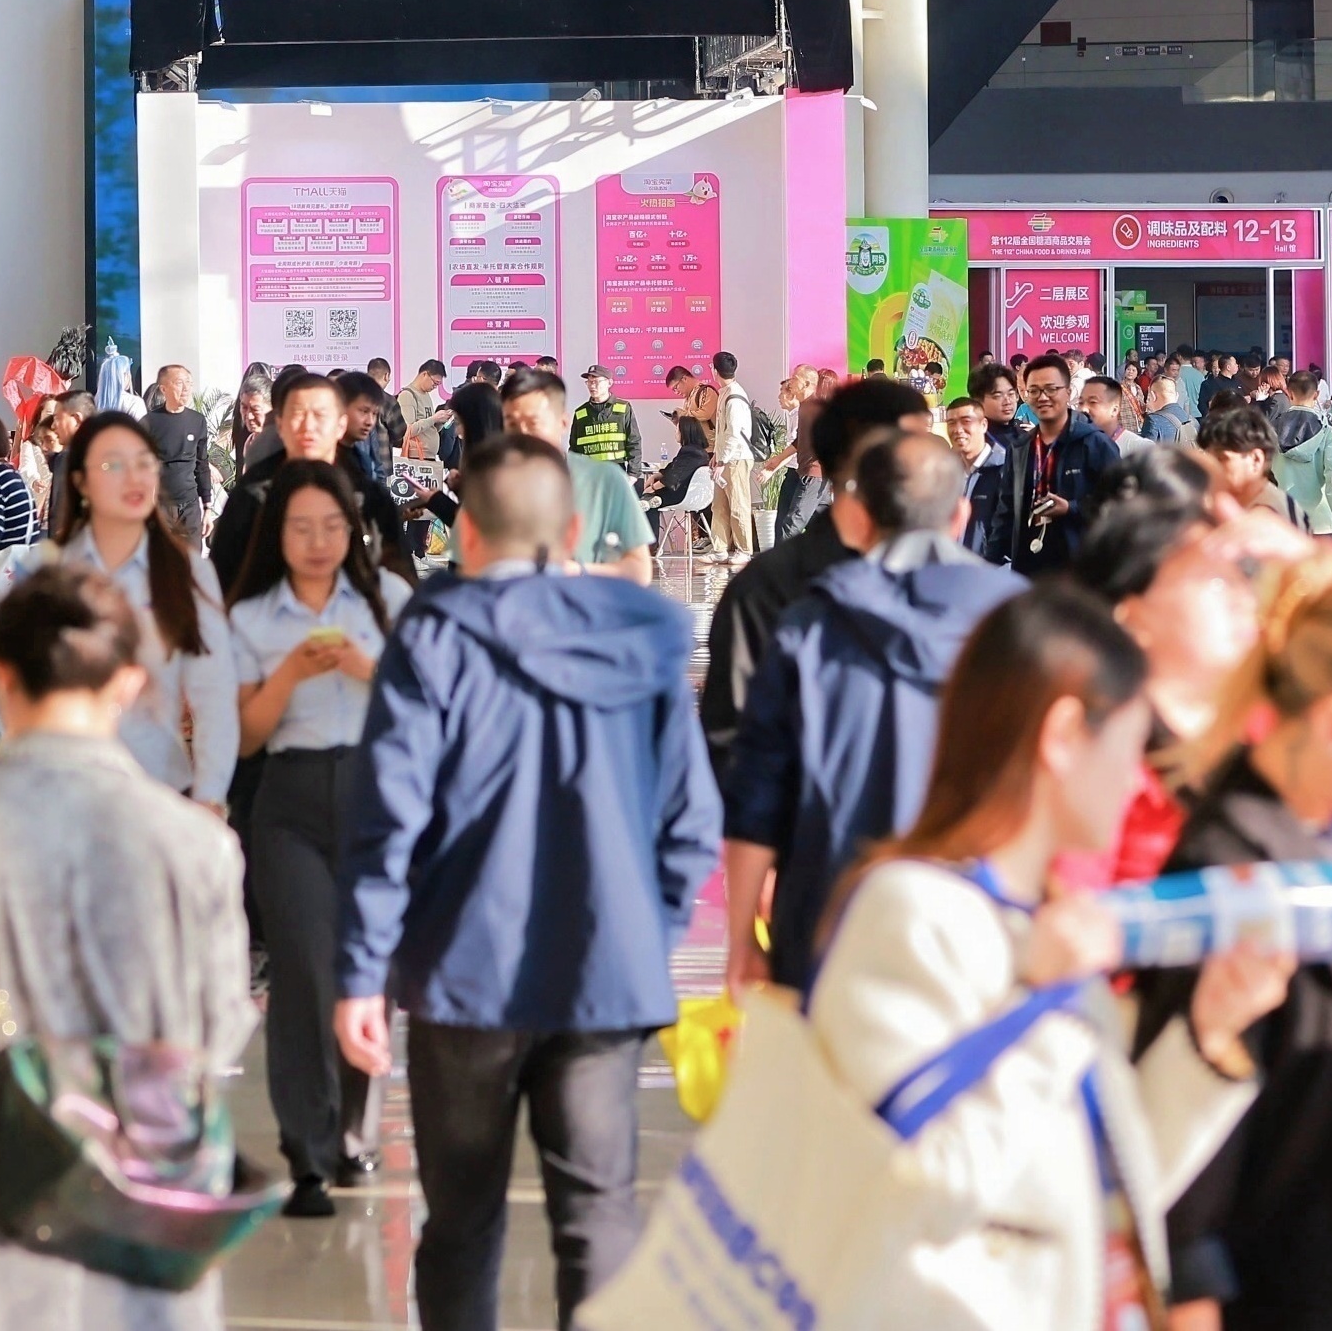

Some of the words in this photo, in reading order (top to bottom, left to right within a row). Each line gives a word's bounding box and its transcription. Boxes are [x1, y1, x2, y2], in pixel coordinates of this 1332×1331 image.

[640, 198, 676, 208] 火热招商
[1146, 220, 1228, 237] 调味品及配料
[1232, 218, 1297, 243] 12-13
[990, 235, 1092, 247] 第112届全国糖酒商品交易会
[1146, 239, 1200, 249] INGREDIENTS
[991, 248, 1003, 256] THE
[1015, 248, 1034, 256] CHINA
[1034, 248, 1051, 256] FOOD
[1051, 248, 1056, 256] &
[1056, 248, 1078, 256] DRINKS
[1078, 248, 1092, 256] FAIR
[1274, 244, 1288, 253] Hall
[1288, 244, 1297, 253] 馆
[1039, 286, 1090, 301] 二层展区
[1040, 314, 1090, 329] 欢迎参观
[1039, 332, 1090, 343] WELCOME
